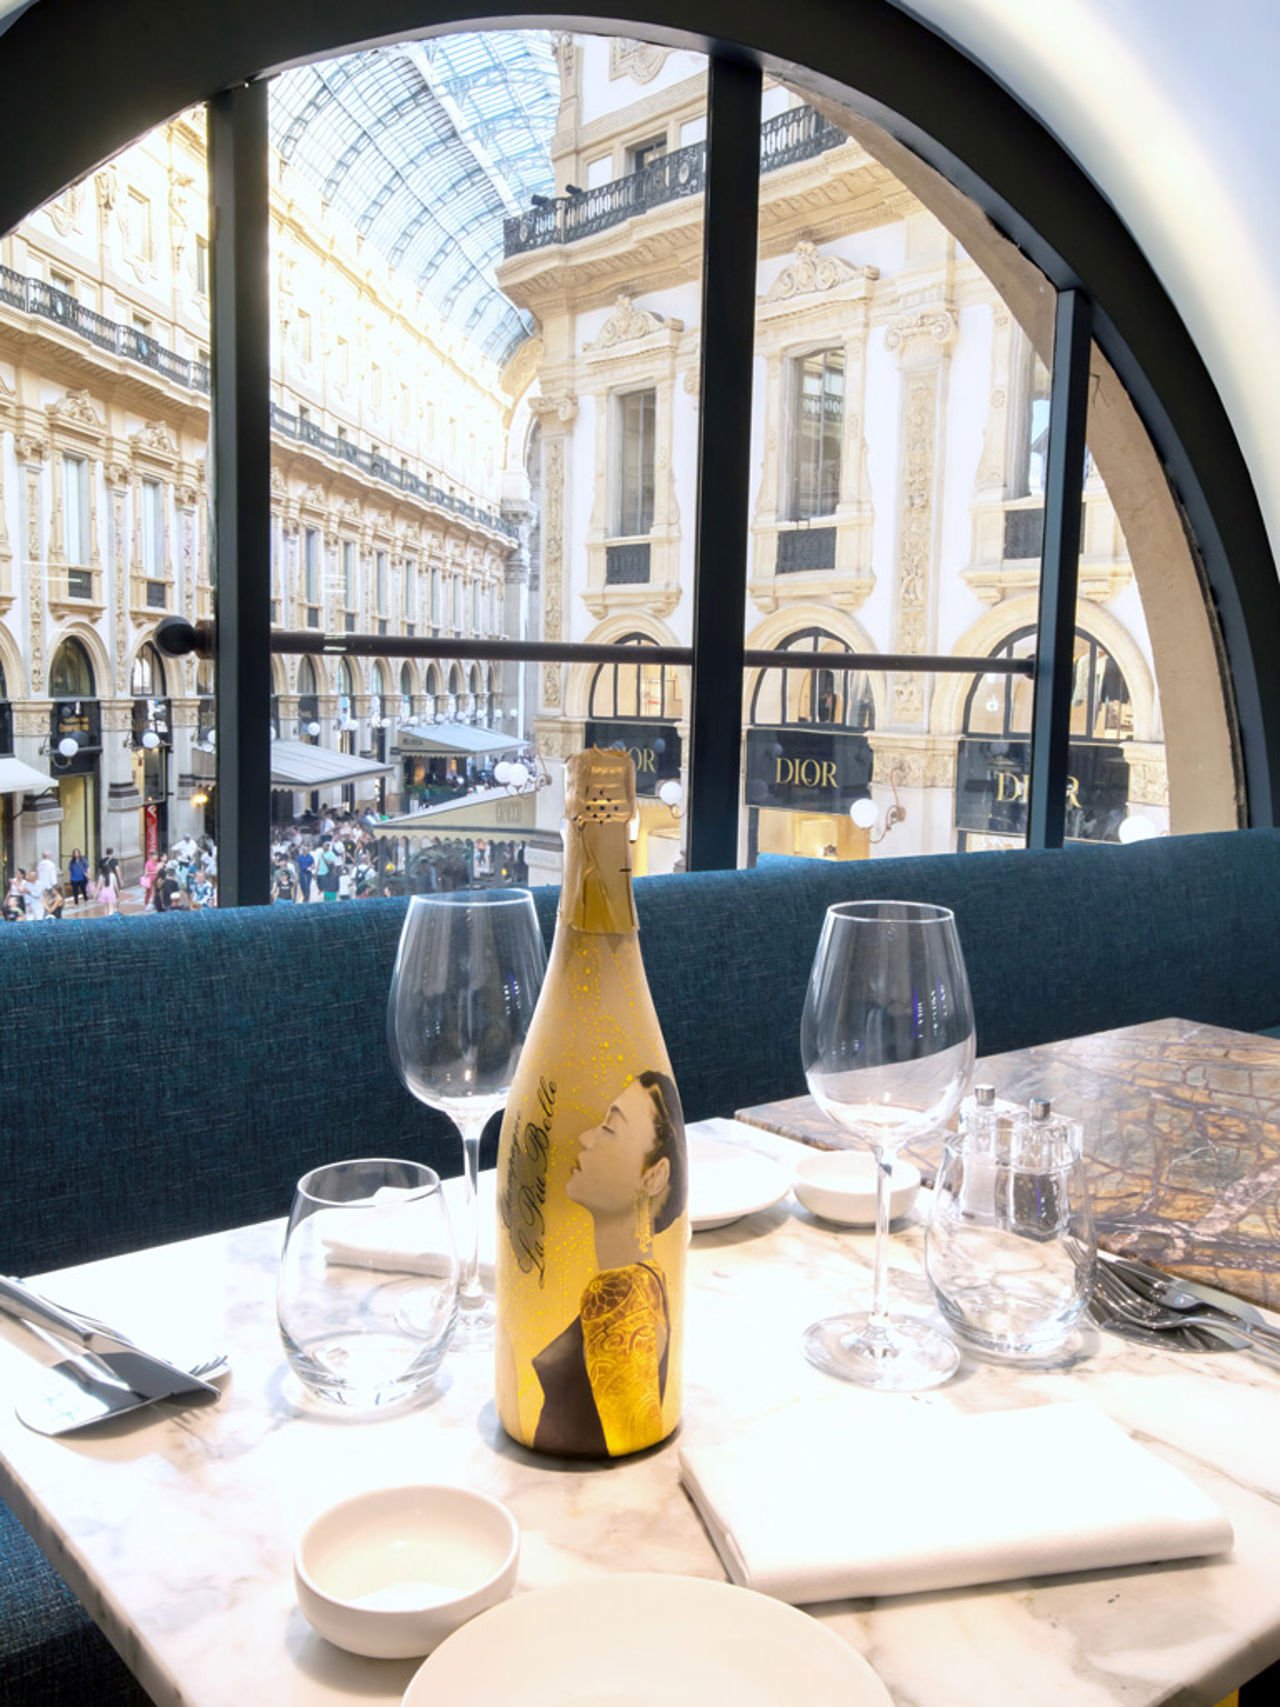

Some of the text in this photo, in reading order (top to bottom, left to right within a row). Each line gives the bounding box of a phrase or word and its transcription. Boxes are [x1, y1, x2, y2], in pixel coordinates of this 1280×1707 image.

[776, 758, 839, 788] DIOR
[996, 770, 1082, 808] DIR
[524, 1075, 558, 1172] Belle
[517, 1229, 546, 1289] La
